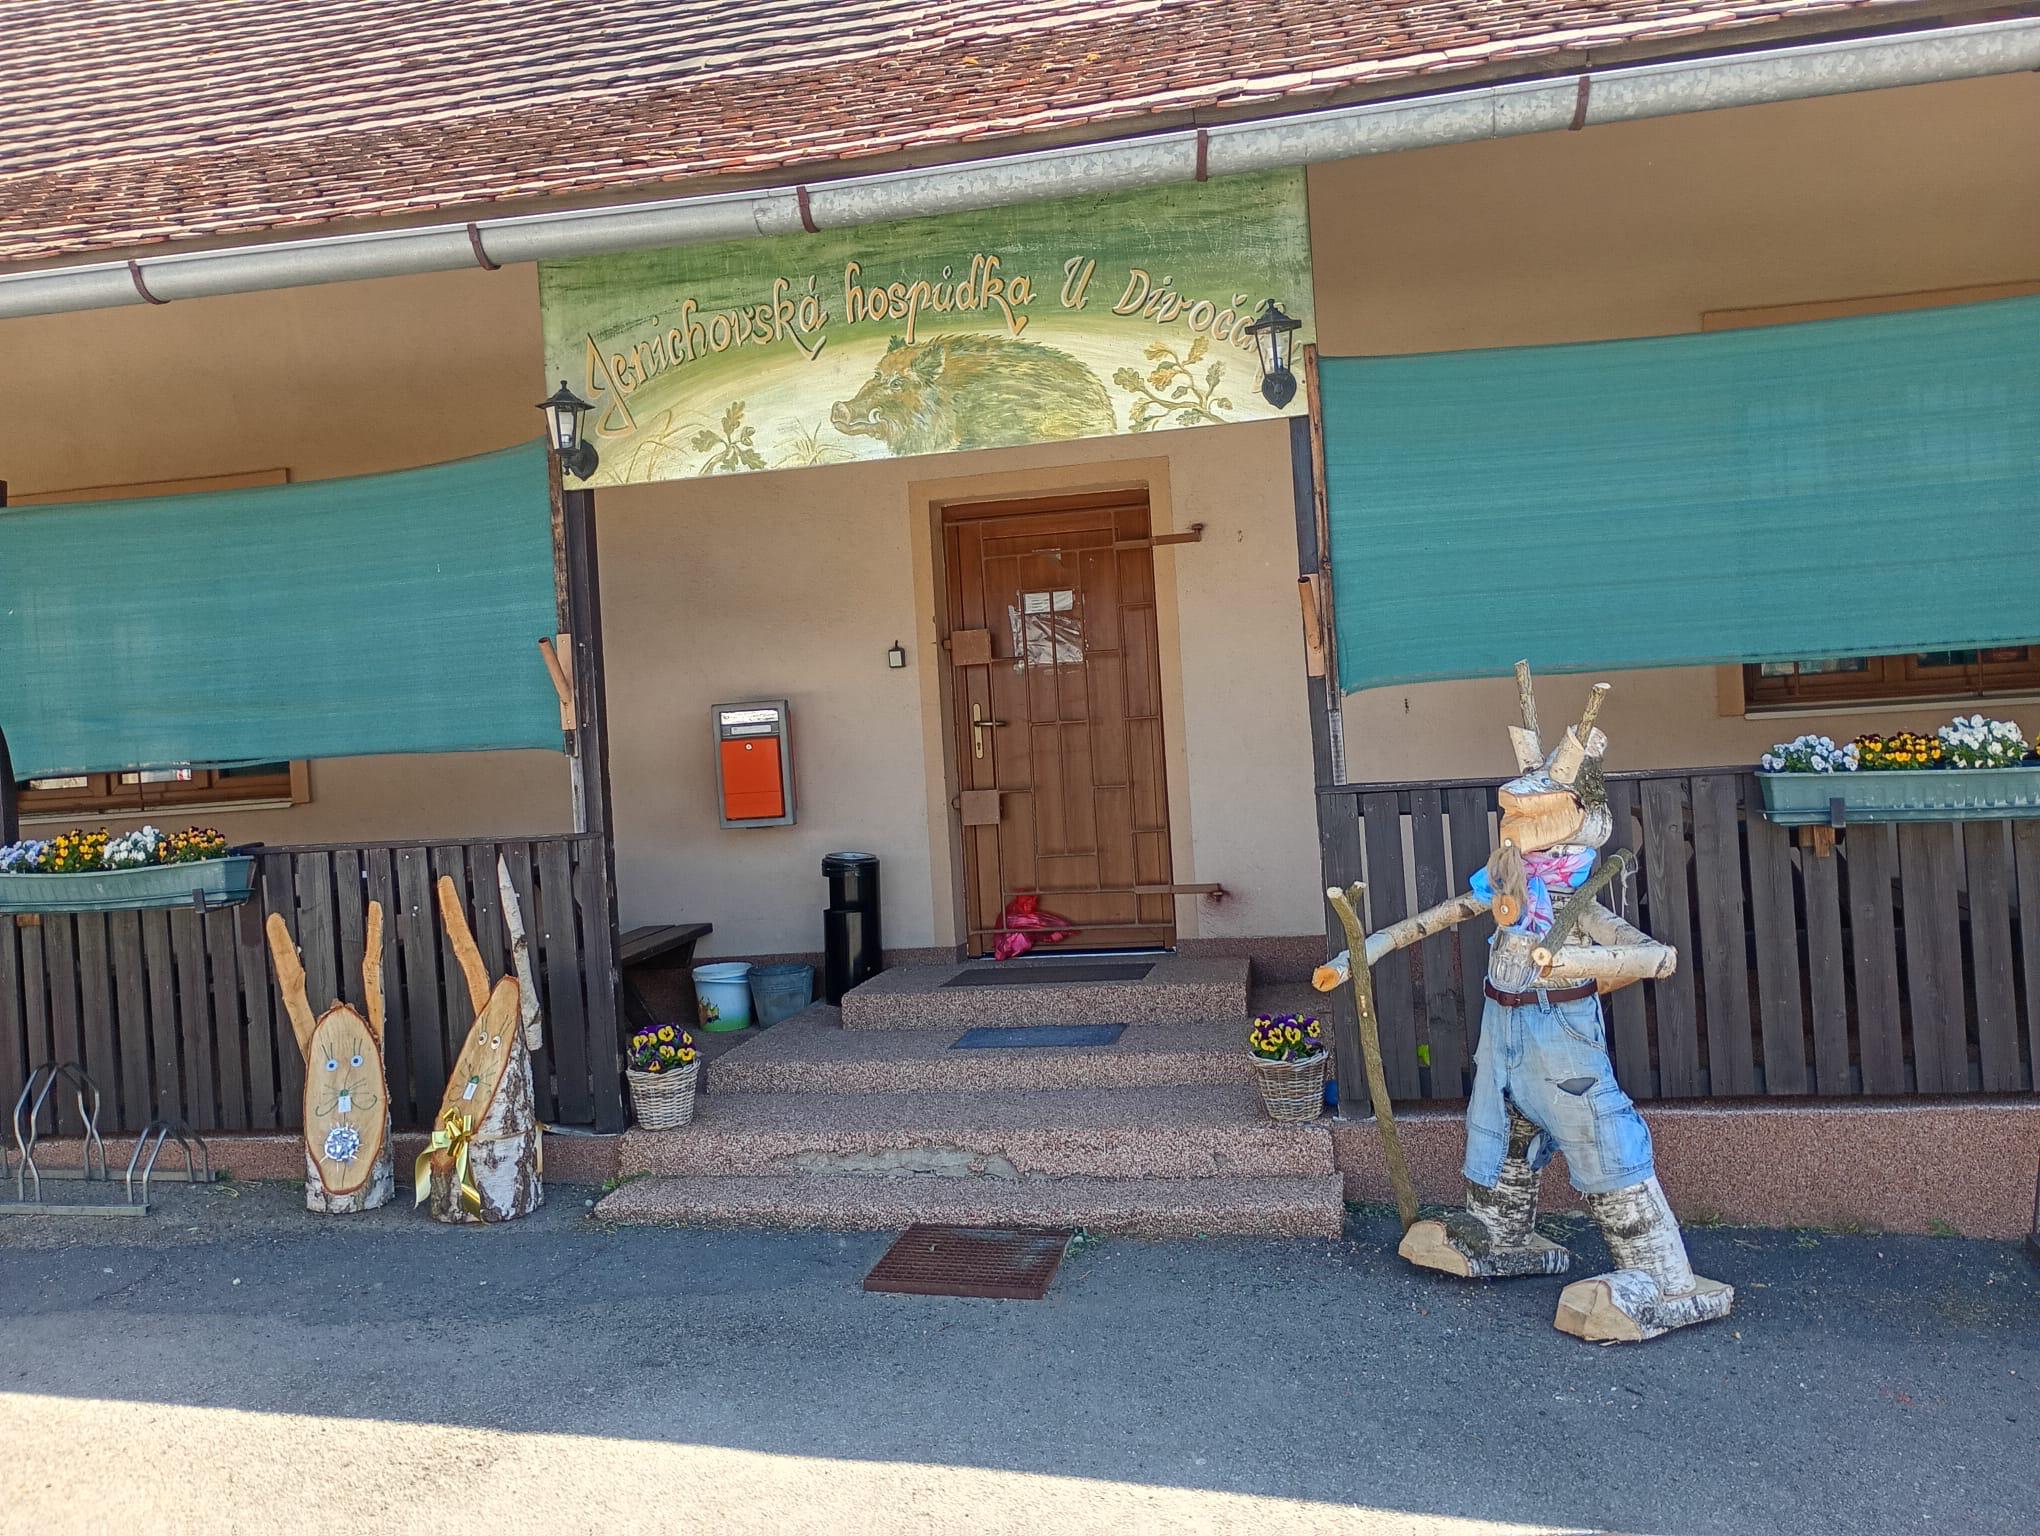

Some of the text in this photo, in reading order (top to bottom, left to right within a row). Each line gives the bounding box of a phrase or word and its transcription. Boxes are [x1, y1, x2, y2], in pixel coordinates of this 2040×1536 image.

[585, 274, 829, 439] Jenichovská
[844, 252, 1038, 346] hospůdka
[1060, 255, 1097, 310] U
